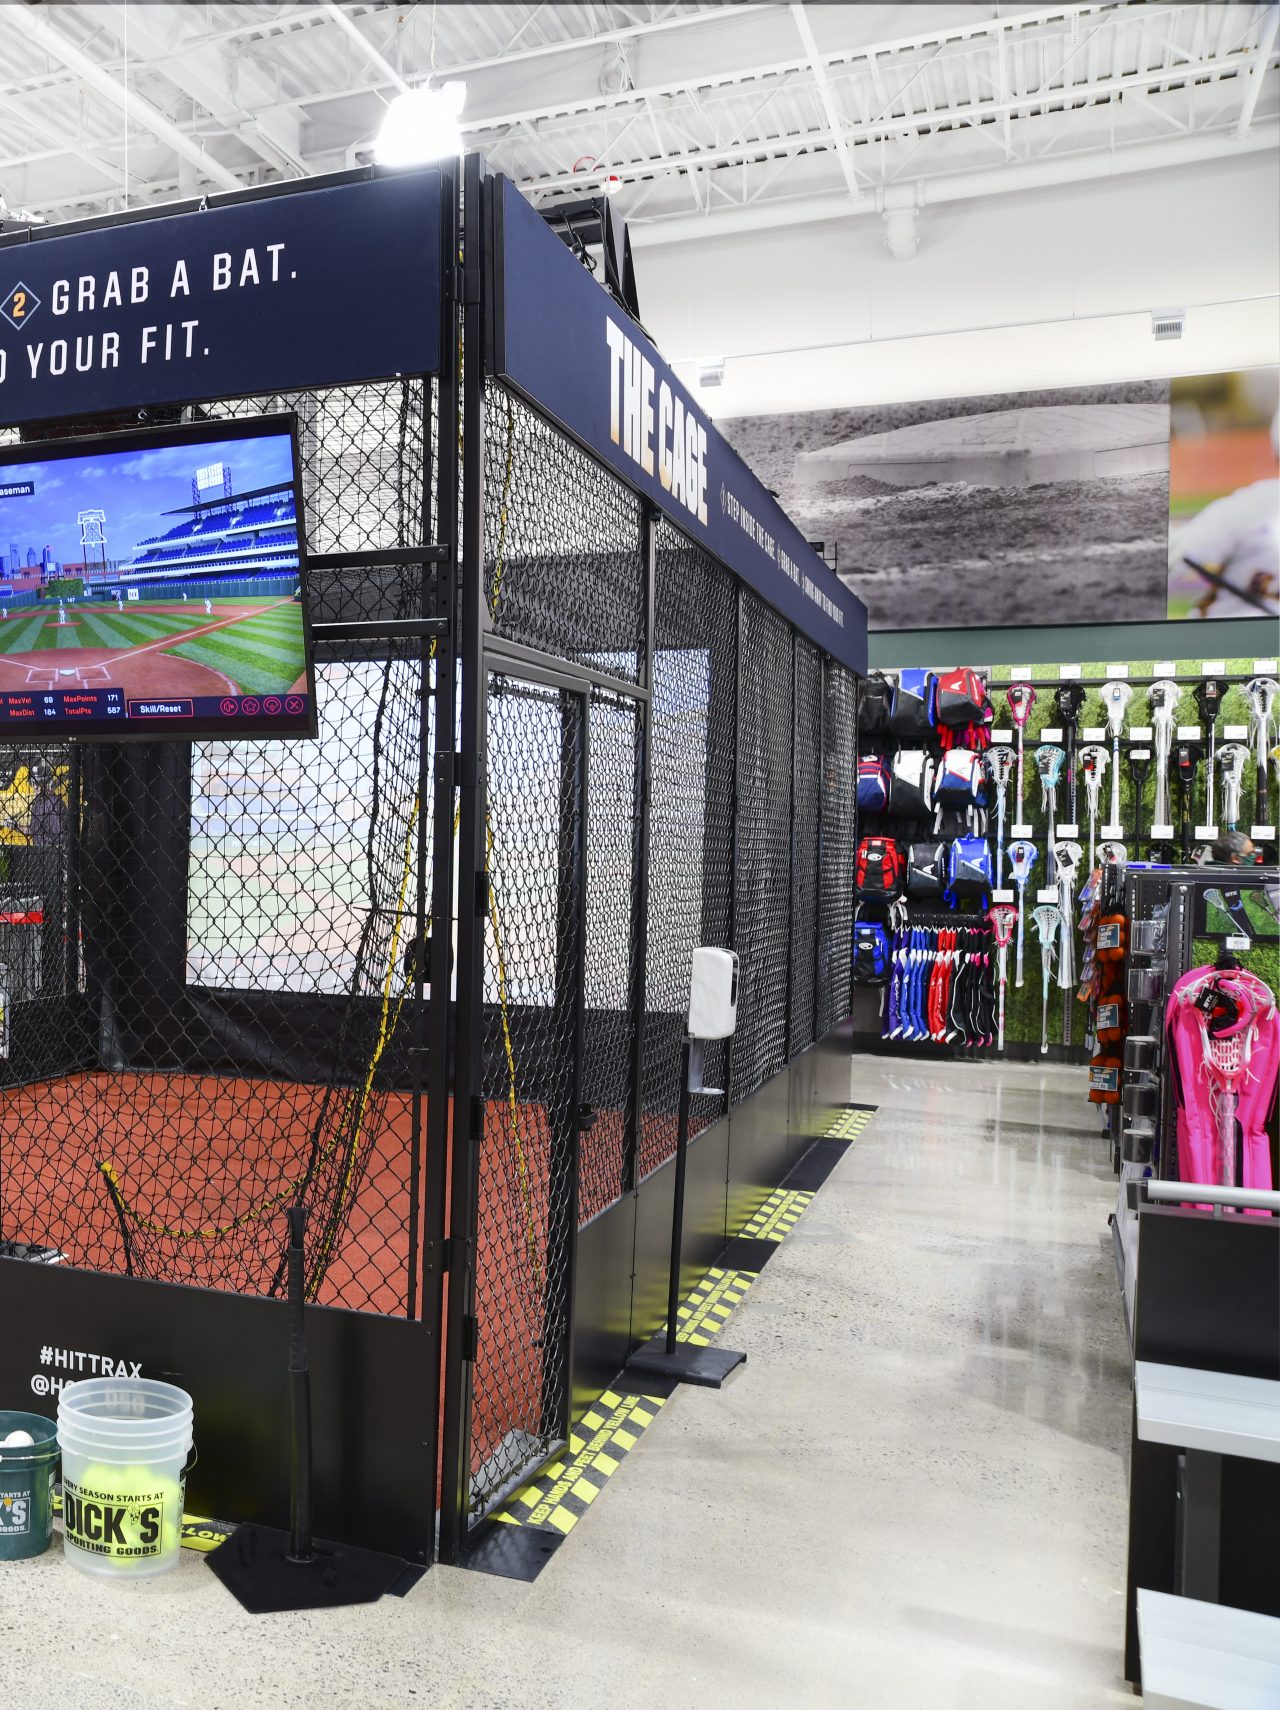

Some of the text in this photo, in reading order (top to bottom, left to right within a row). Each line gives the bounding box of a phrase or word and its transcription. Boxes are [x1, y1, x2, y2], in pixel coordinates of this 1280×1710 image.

[12, 292, 26, 318] 2
[52, 265, 150, 315] GRAB
[170, 259, 191, 298] A
[212, 243, 298, 292] BAT.
[26, 330, 120, 379] YOUR
[140, 319, 211, 364] FIT.
[606, 315, 708, 527] THE CAGE
[8, 696, 32, 705] MaxVel
[63, 694, 98, 703] MaxPoints
[107, 694, 118, 702] 171
[9, 709, 35, 717] MaxDist
[64, 707, 92, 715] TotalPts
[140, 704, 182, 714] Skill/Reset
[1224, 890, 1238, 898] STX
[1202, 993, 1214, 1009] STX
[39, 1345, 143, 1379] #HITTRAX
[526, 1395, 641, 1526] KEEP HANDS AND FEET BEHIND YELLOW LINE
[79, 1486, 114, 1502] SEASON
[116, 1493, 152, 1502] STARTS
[153, 1491, 165, 1500] AT
[64, 1490, 160, 1545] DICK'S
[66, 1529, 112, 1555] SPORTING
